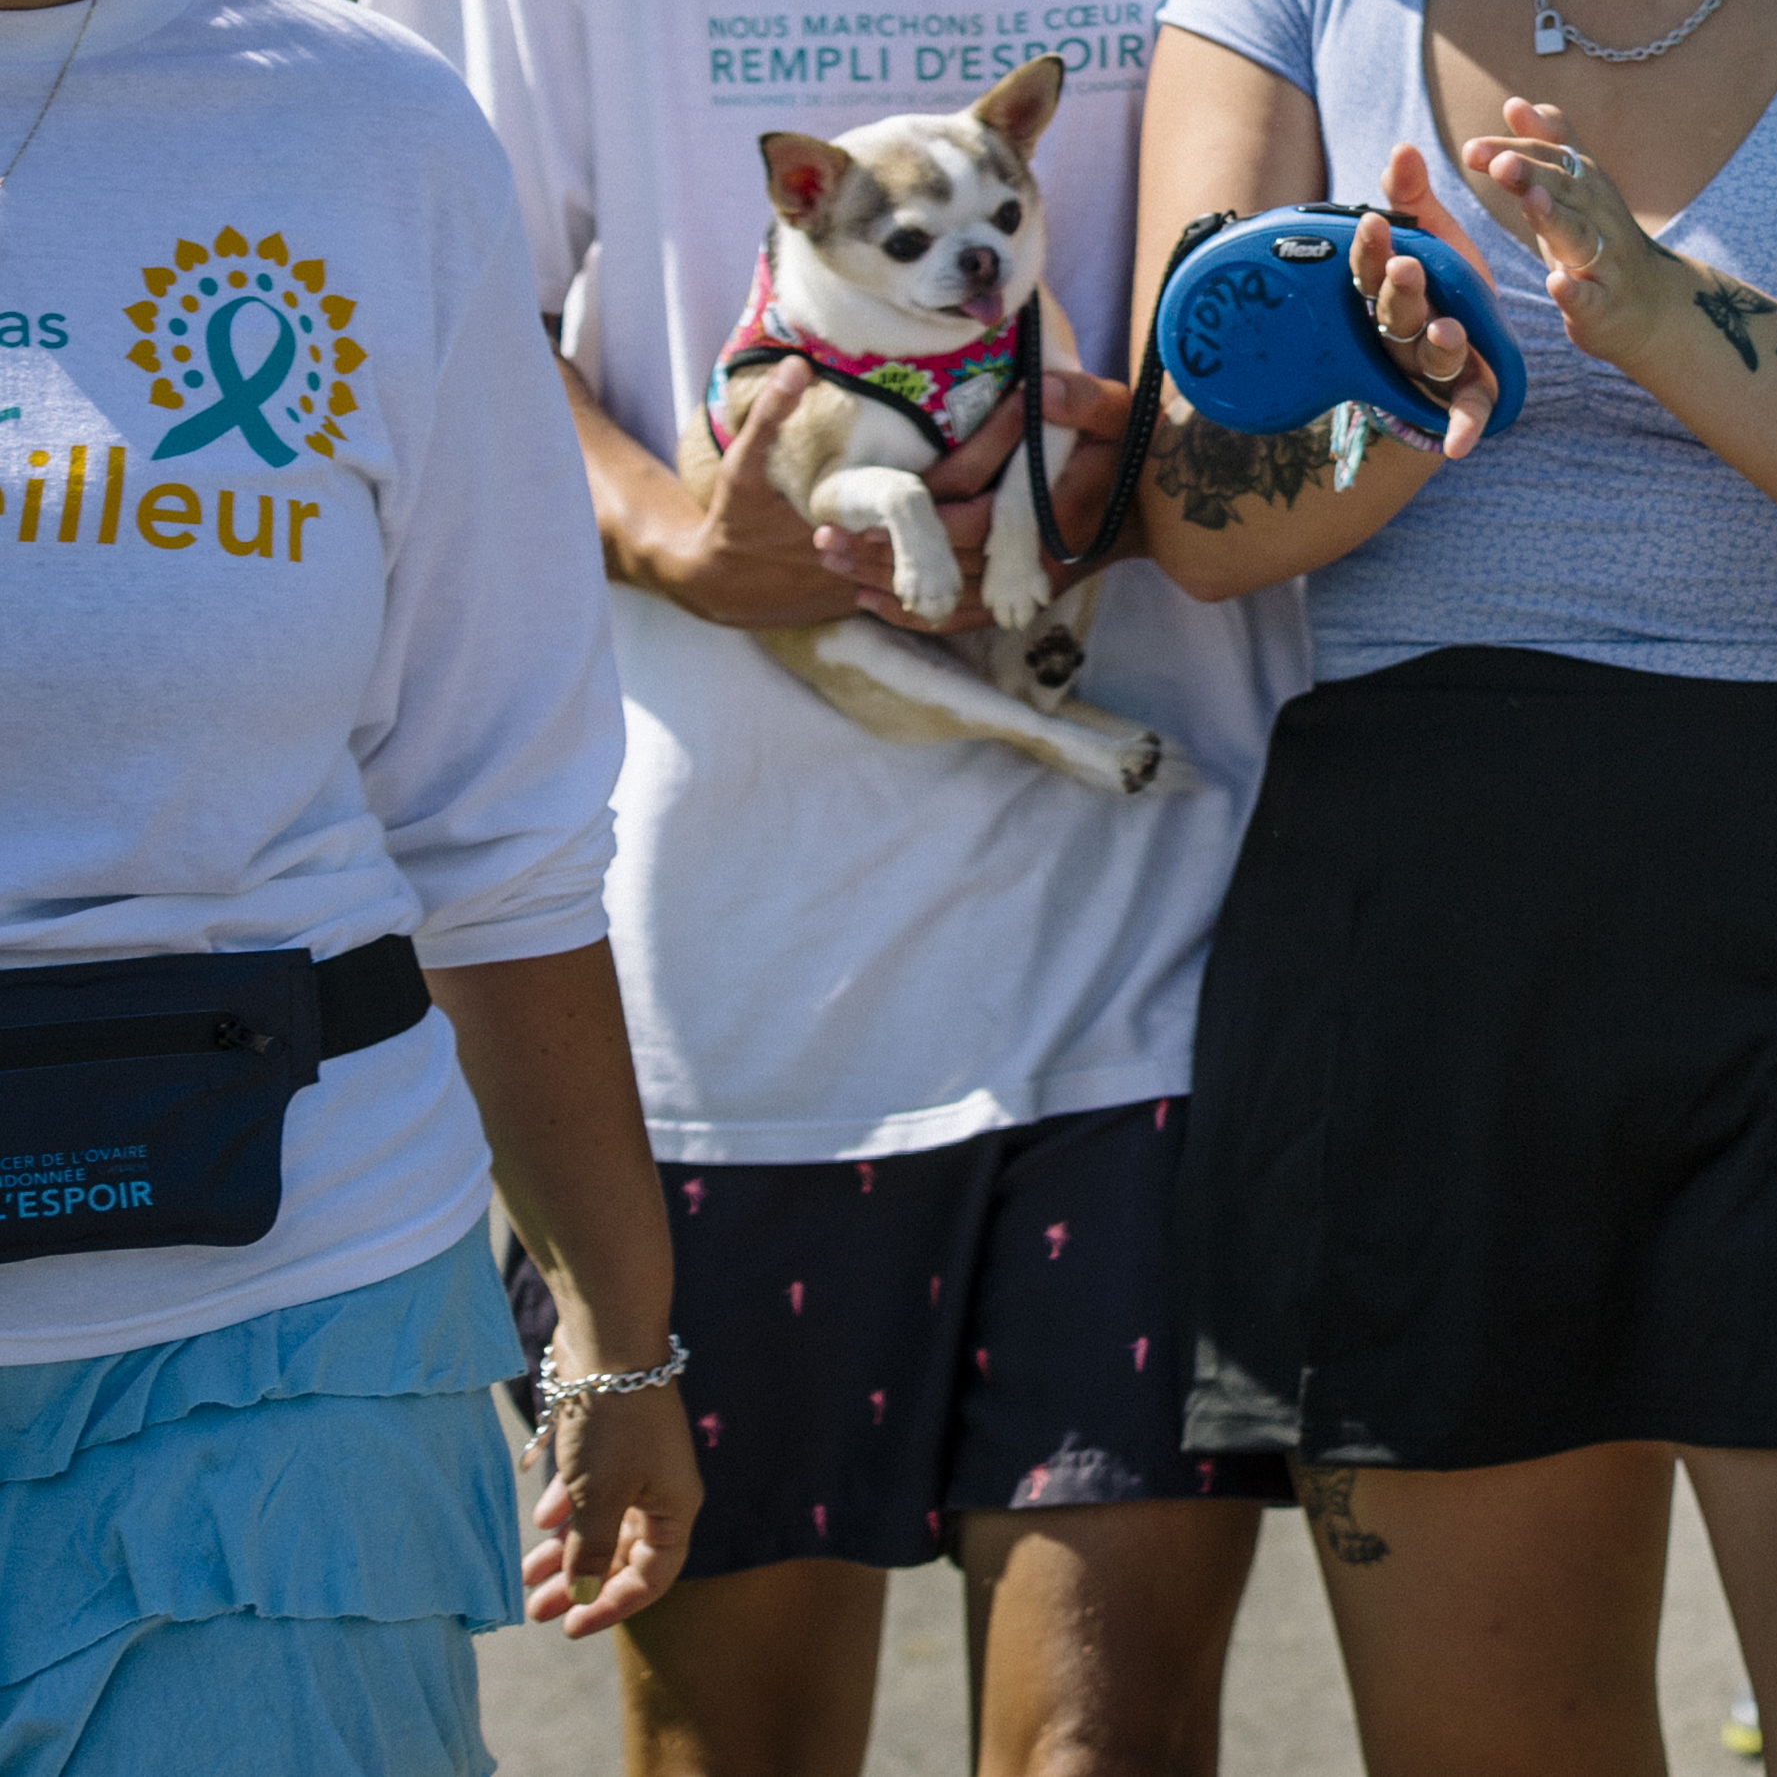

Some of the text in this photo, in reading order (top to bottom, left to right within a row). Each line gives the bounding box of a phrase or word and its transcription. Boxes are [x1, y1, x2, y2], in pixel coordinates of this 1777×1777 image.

[709, 2, 1141, 40] NOUS MARCHONS LE CŒUR
[710, 45, 890, 84] REMPLI
[0, 444, 321, 563] illeur
[41, 1152, 66, 1168] DE
[71, 1144, 148, 1165] L'OVAIRE
[0, 1179, 154, 1221] 'ESPOIR
